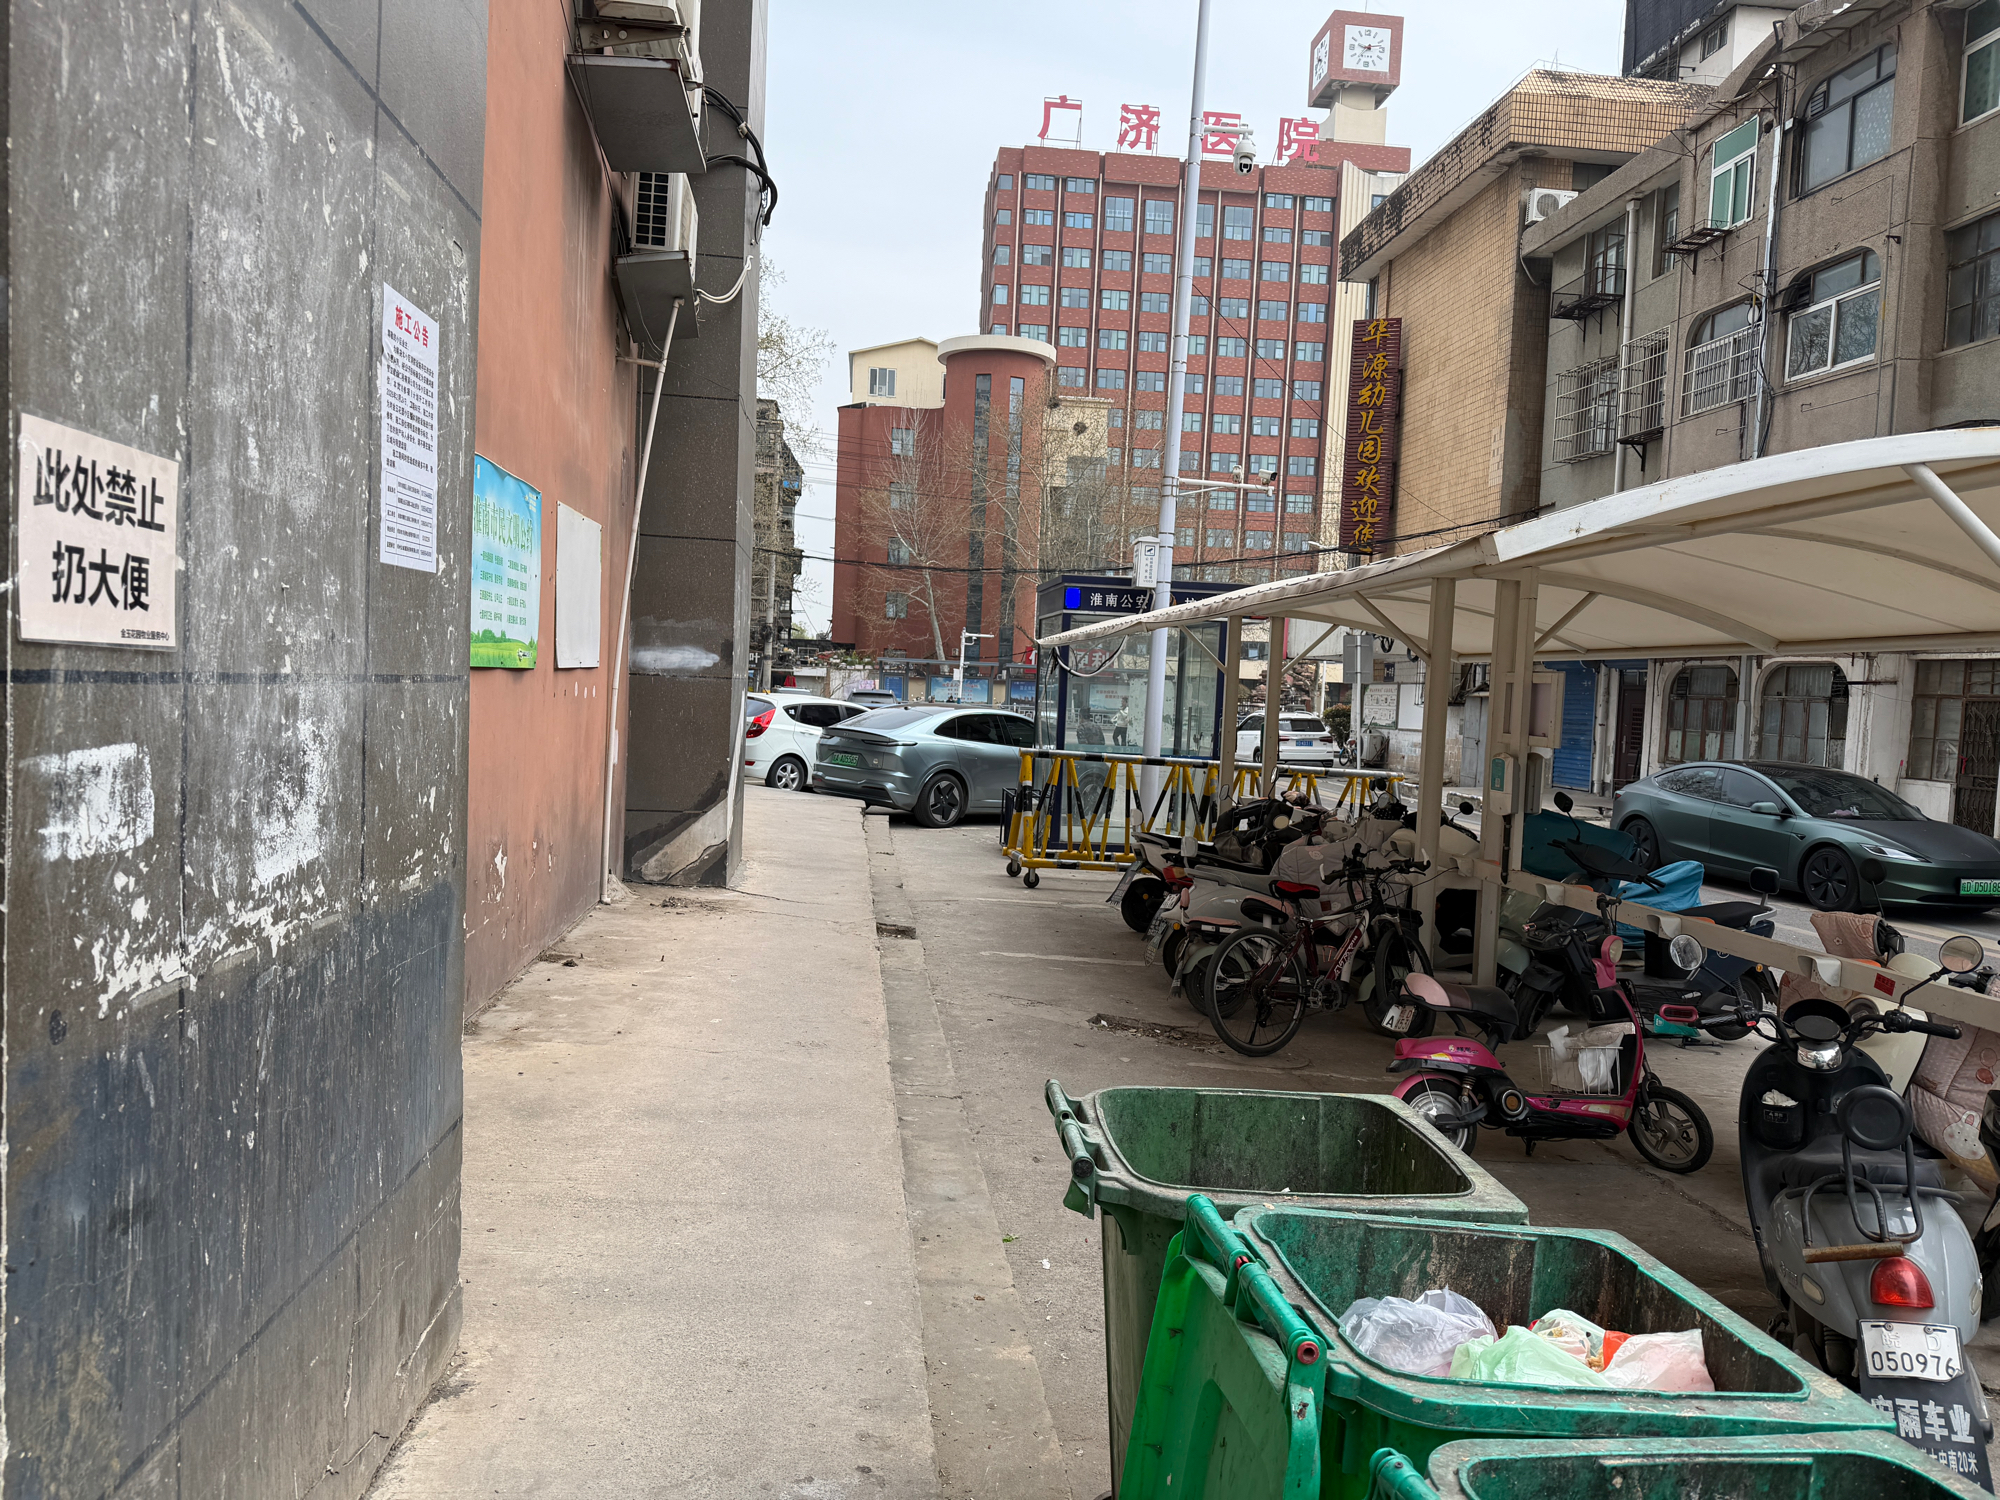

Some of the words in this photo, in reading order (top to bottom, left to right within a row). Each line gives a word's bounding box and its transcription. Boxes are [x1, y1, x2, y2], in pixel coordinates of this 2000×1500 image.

[1037, 95, 1320, 162] 广济医院
[395, 304, 429, 348] 施工公告
[1349, 318, 1391, 553] 华源幼儿园欢迎您
[33, 446, 166, 534] 此处禁止
[51, 540, 151, 612] 扔大便
[1090, 592, 1148, 610] 淮南公安
[1871, 1350, 1957, 1378] 050976
